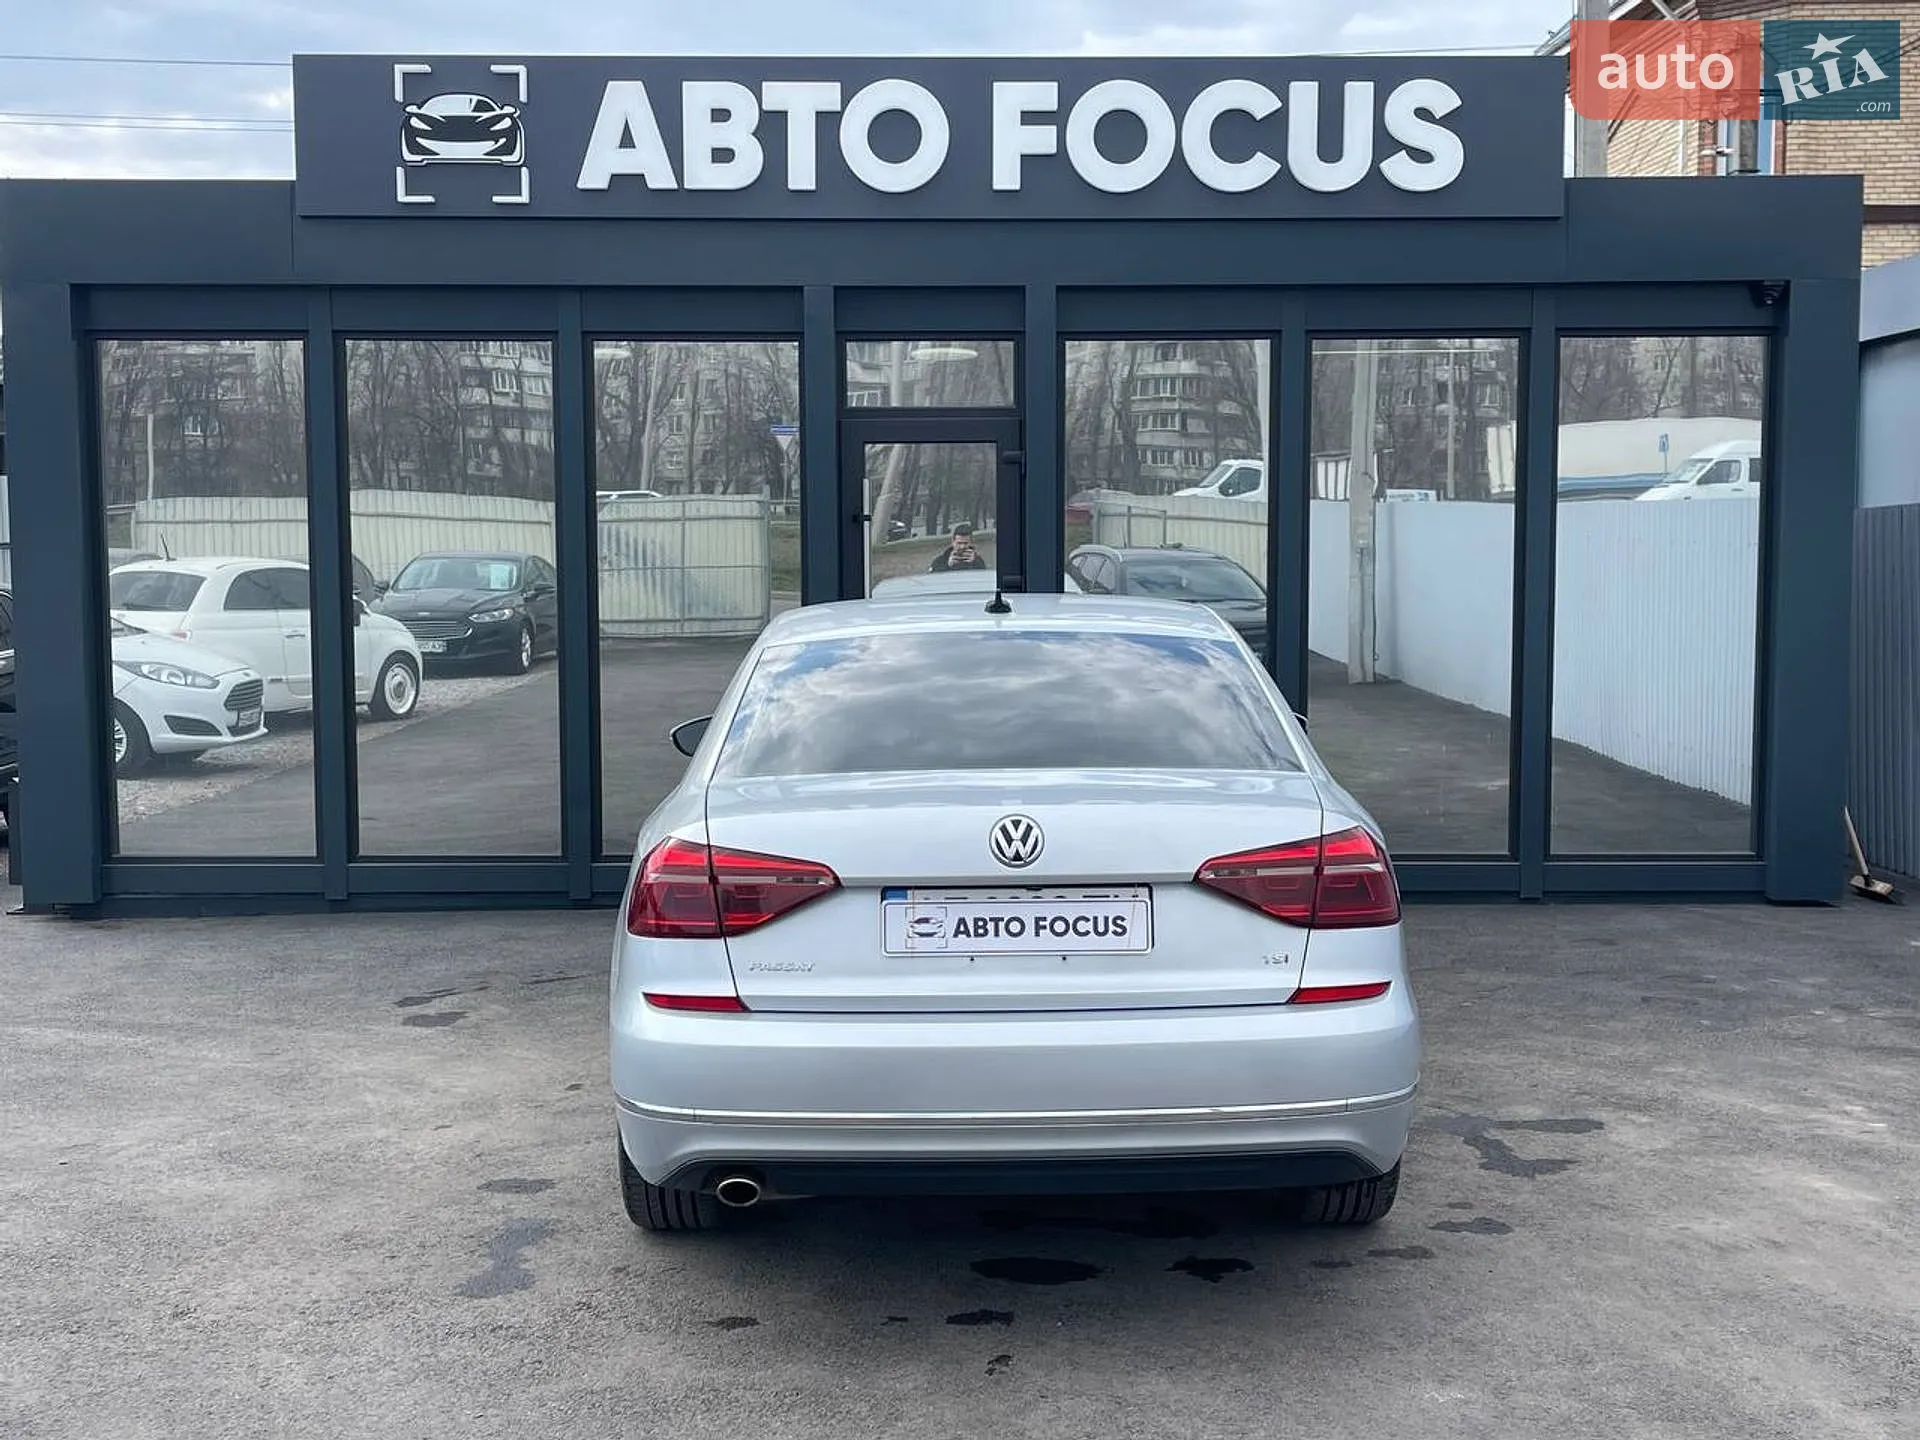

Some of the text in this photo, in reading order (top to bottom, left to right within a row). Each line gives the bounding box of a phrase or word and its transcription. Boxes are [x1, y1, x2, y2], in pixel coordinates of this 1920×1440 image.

[577, 78, 1465, 193] АВТО FOCUS
[953, 915, 1128, 938] АВТО FOCUS
